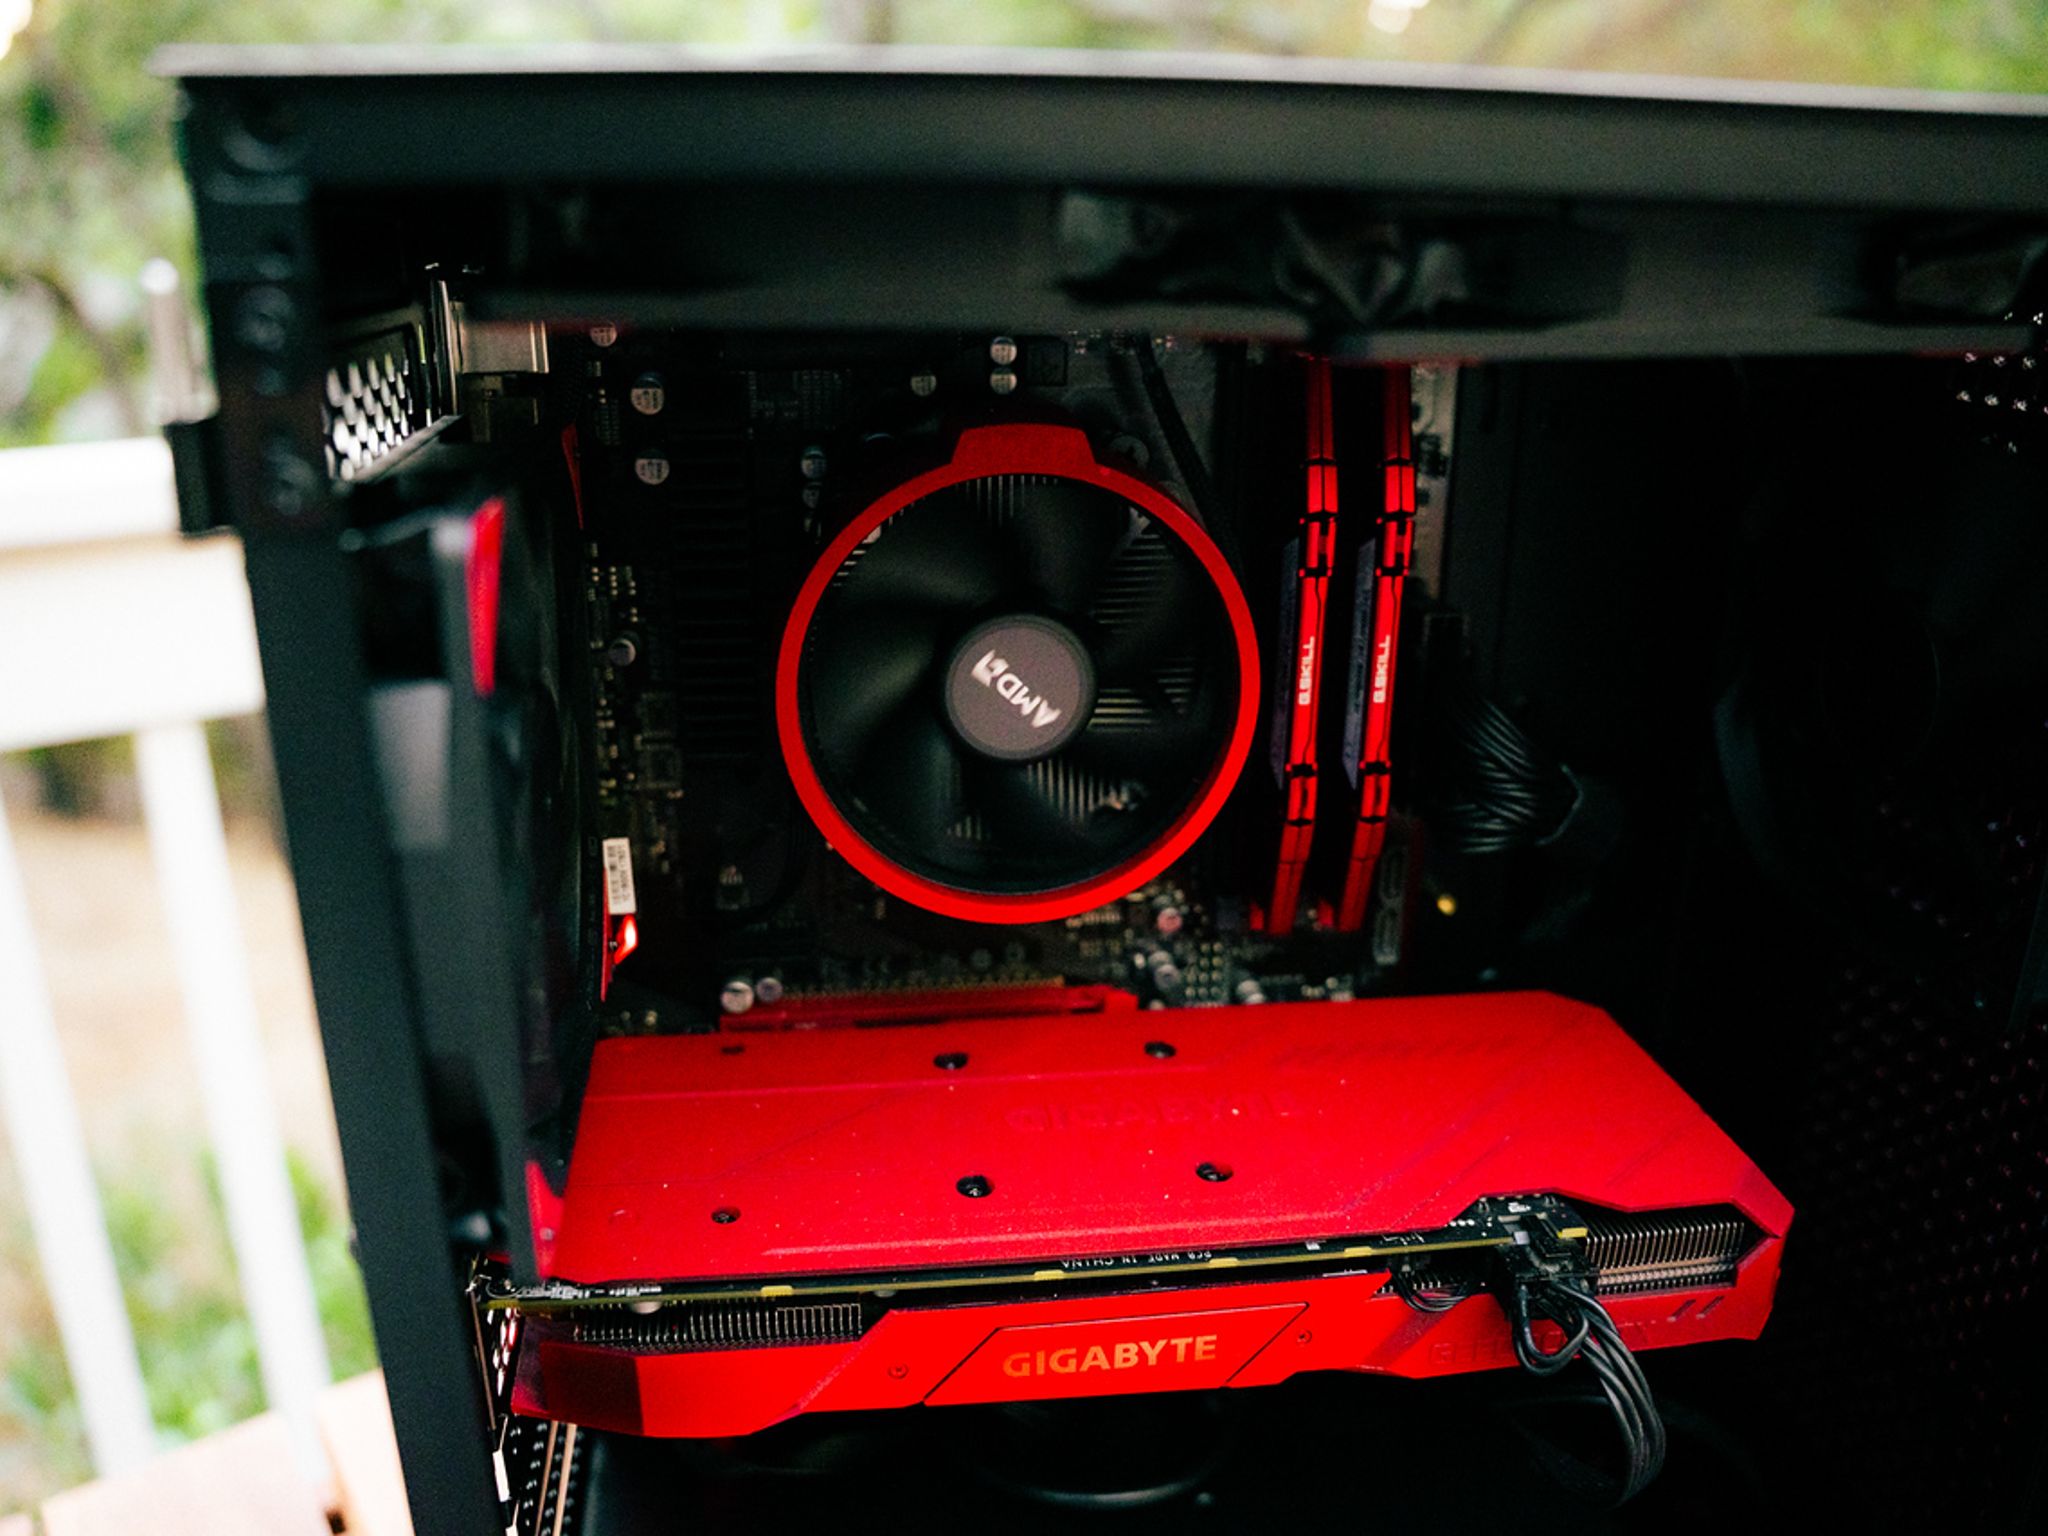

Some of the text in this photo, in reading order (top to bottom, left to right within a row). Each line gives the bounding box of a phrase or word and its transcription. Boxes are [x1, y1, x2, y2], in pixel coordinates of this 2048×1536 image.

[995, 672, 1063, 729] AMD
[1297, 635, 1316, 706] G.SKILL
[1372, 633, 1391, 704] G.SKILL
[1002, 1333, 1218, 1378] GIGABYTE
